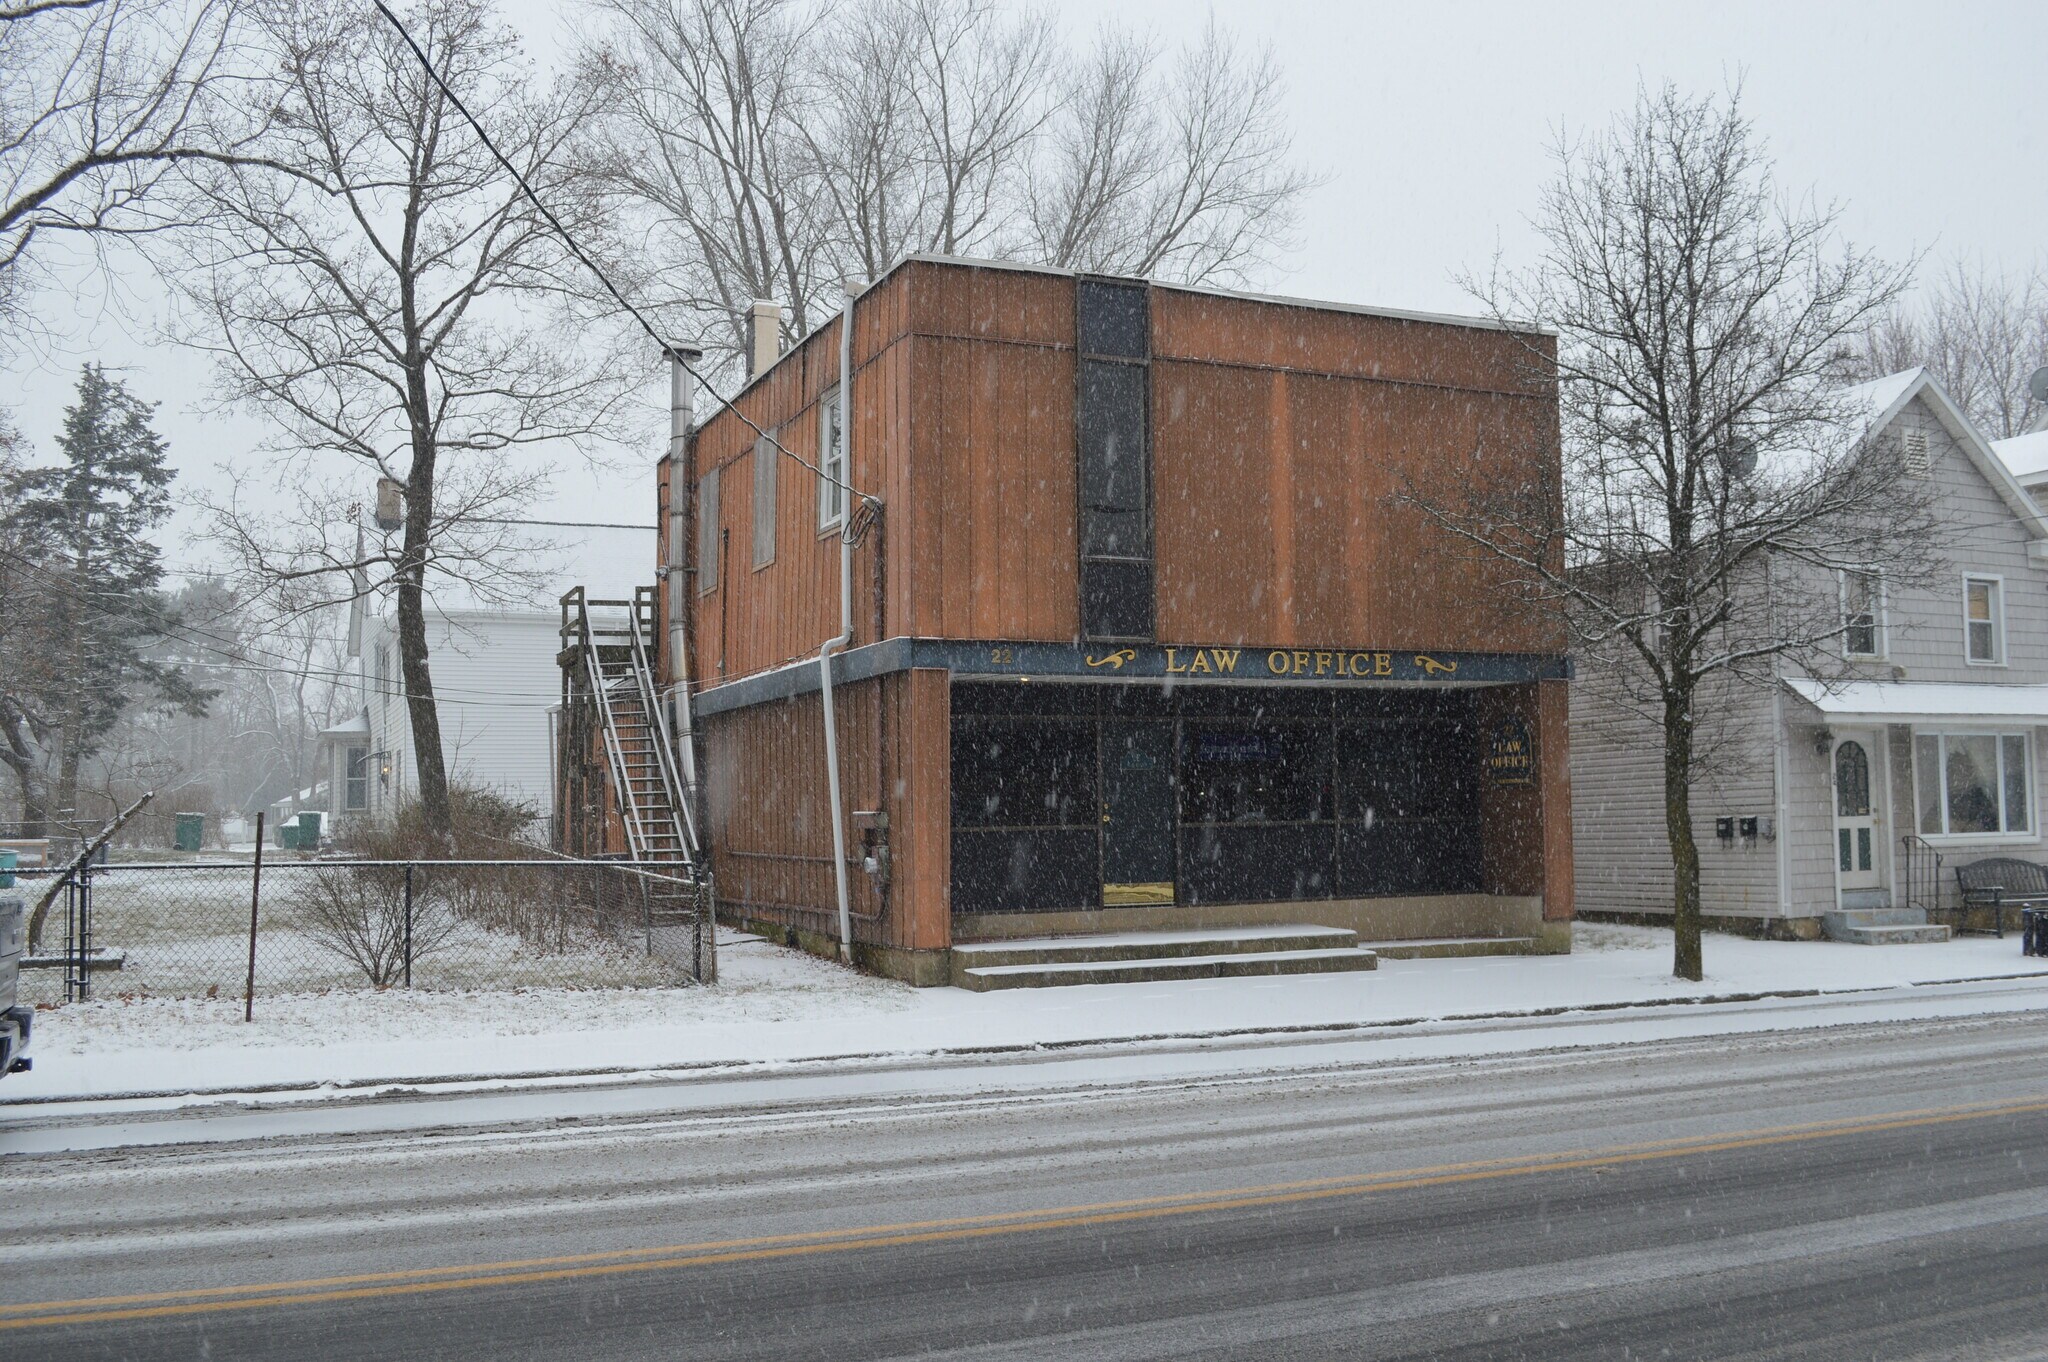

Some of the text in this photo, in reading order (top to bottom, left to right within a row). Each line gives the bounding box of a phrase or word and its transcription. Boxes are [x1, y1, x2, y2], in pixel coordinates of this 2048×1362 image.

[991, 649, 1011, 664] 22
[1165, 649, 1393, 676] LAW OFFICE
[1498, 740, 1522, 753] LAW
[1491, 755, 1529, 768] OFFICE
